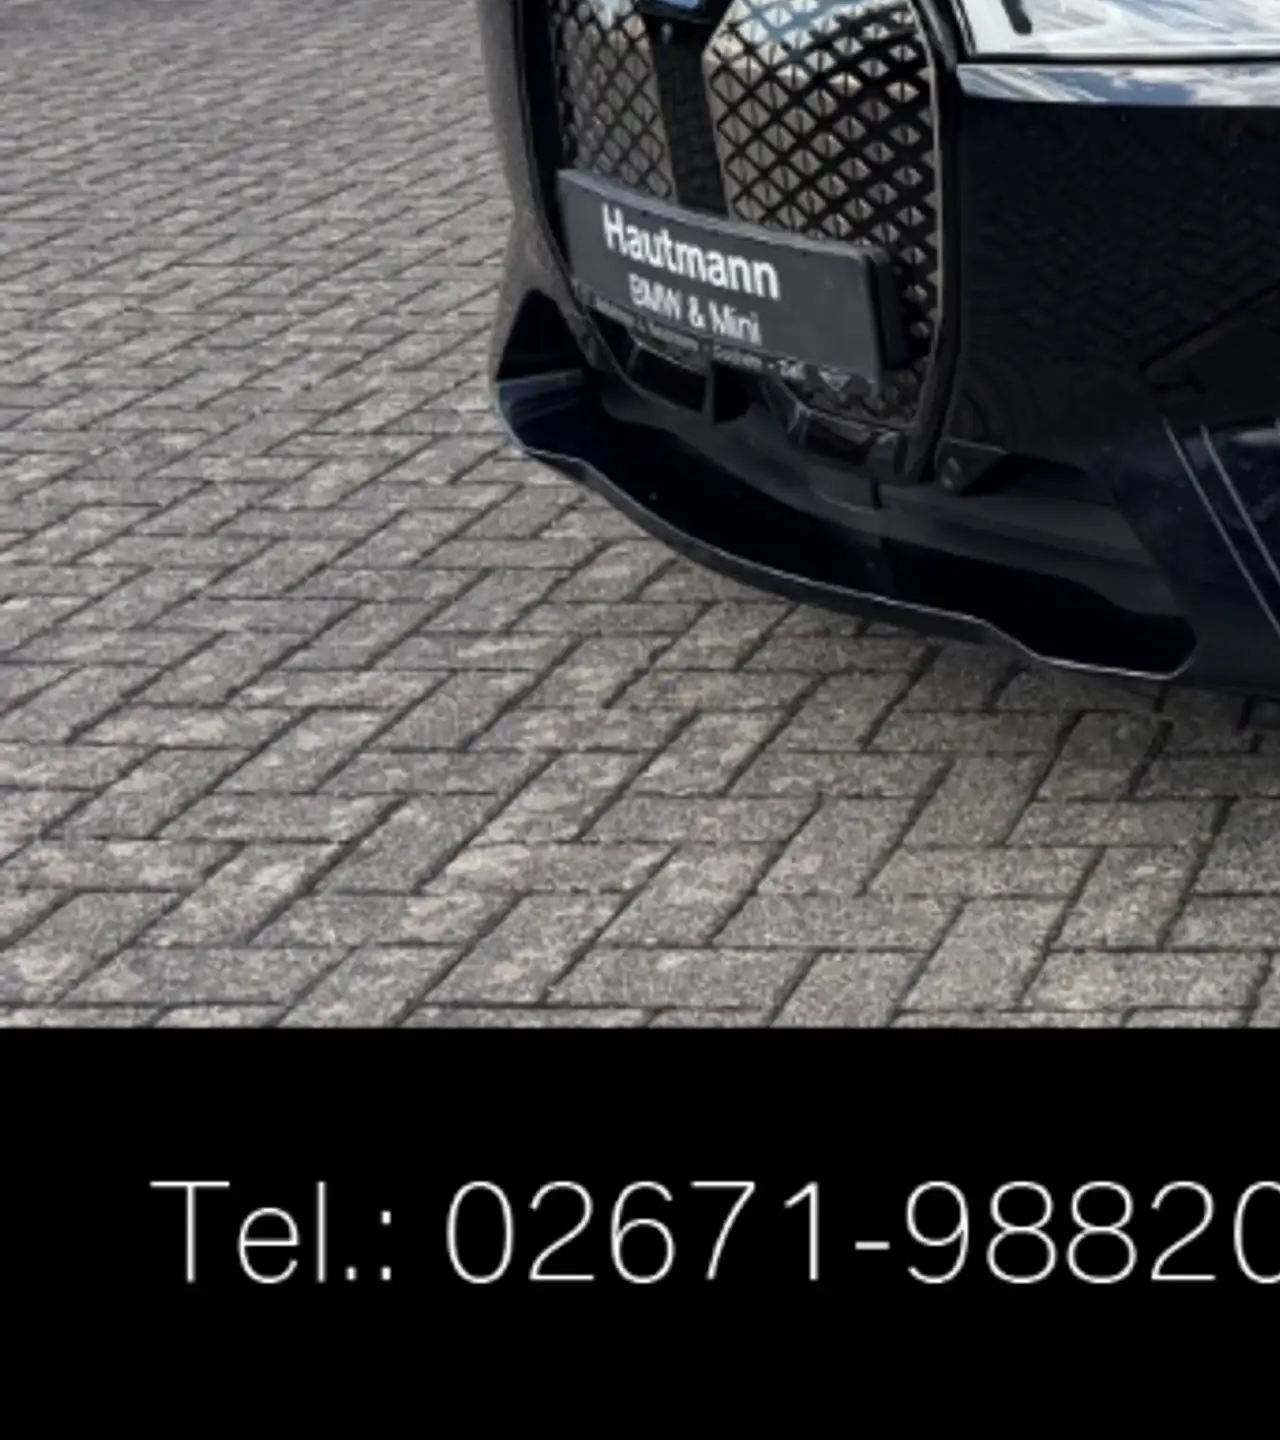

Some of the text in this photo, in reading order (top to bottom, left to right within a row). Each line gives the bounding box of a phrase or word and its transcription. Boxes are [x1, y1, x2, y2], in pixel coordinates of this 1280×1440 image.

[601, 201, 782, 301] Hautmann
[627, 272, 683, 323] BMW
[687, 295, 705, 330] &
[708, 300, 763, 347] Mini
